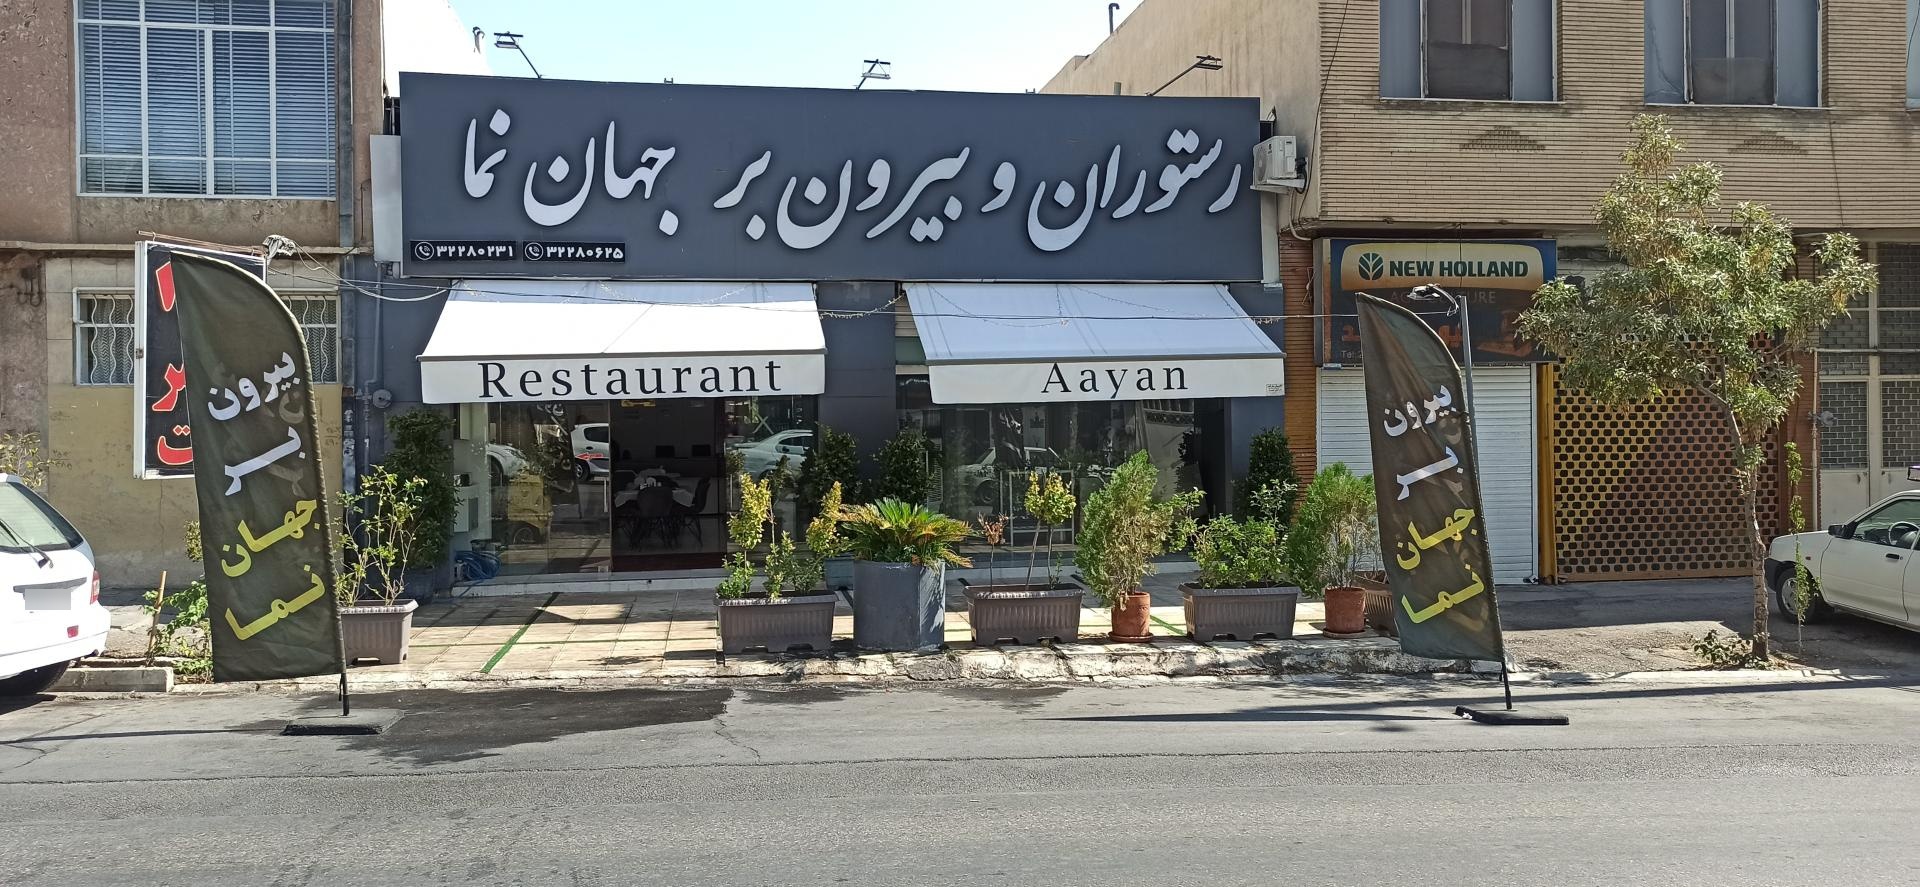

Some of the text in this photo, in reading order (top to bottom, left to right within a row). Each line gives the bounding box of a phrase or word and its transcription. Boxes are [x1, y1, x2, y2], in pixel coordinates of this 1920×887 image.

[465, 109, 1242, 251] رستوران و بیرون بر جهان نما
[1389, 260, 1529, 277] NEW HOLLAND
[208, 352, 301, 421] بیرون
[478, 361, 782, 398] Restaurant
[1041, 362, 1189, 400] Aayan
[1383, 384, 1457, 437] بیرون
[225, 426, 306, 496] بر
[1397, 445, 1464, 501] بر
[222, 499, 320, 578] جهان
[1397, 507, 1477, 570] جهان
[224, 565, 326, 641] نما
[1402, 563, 1485, 624] نما
